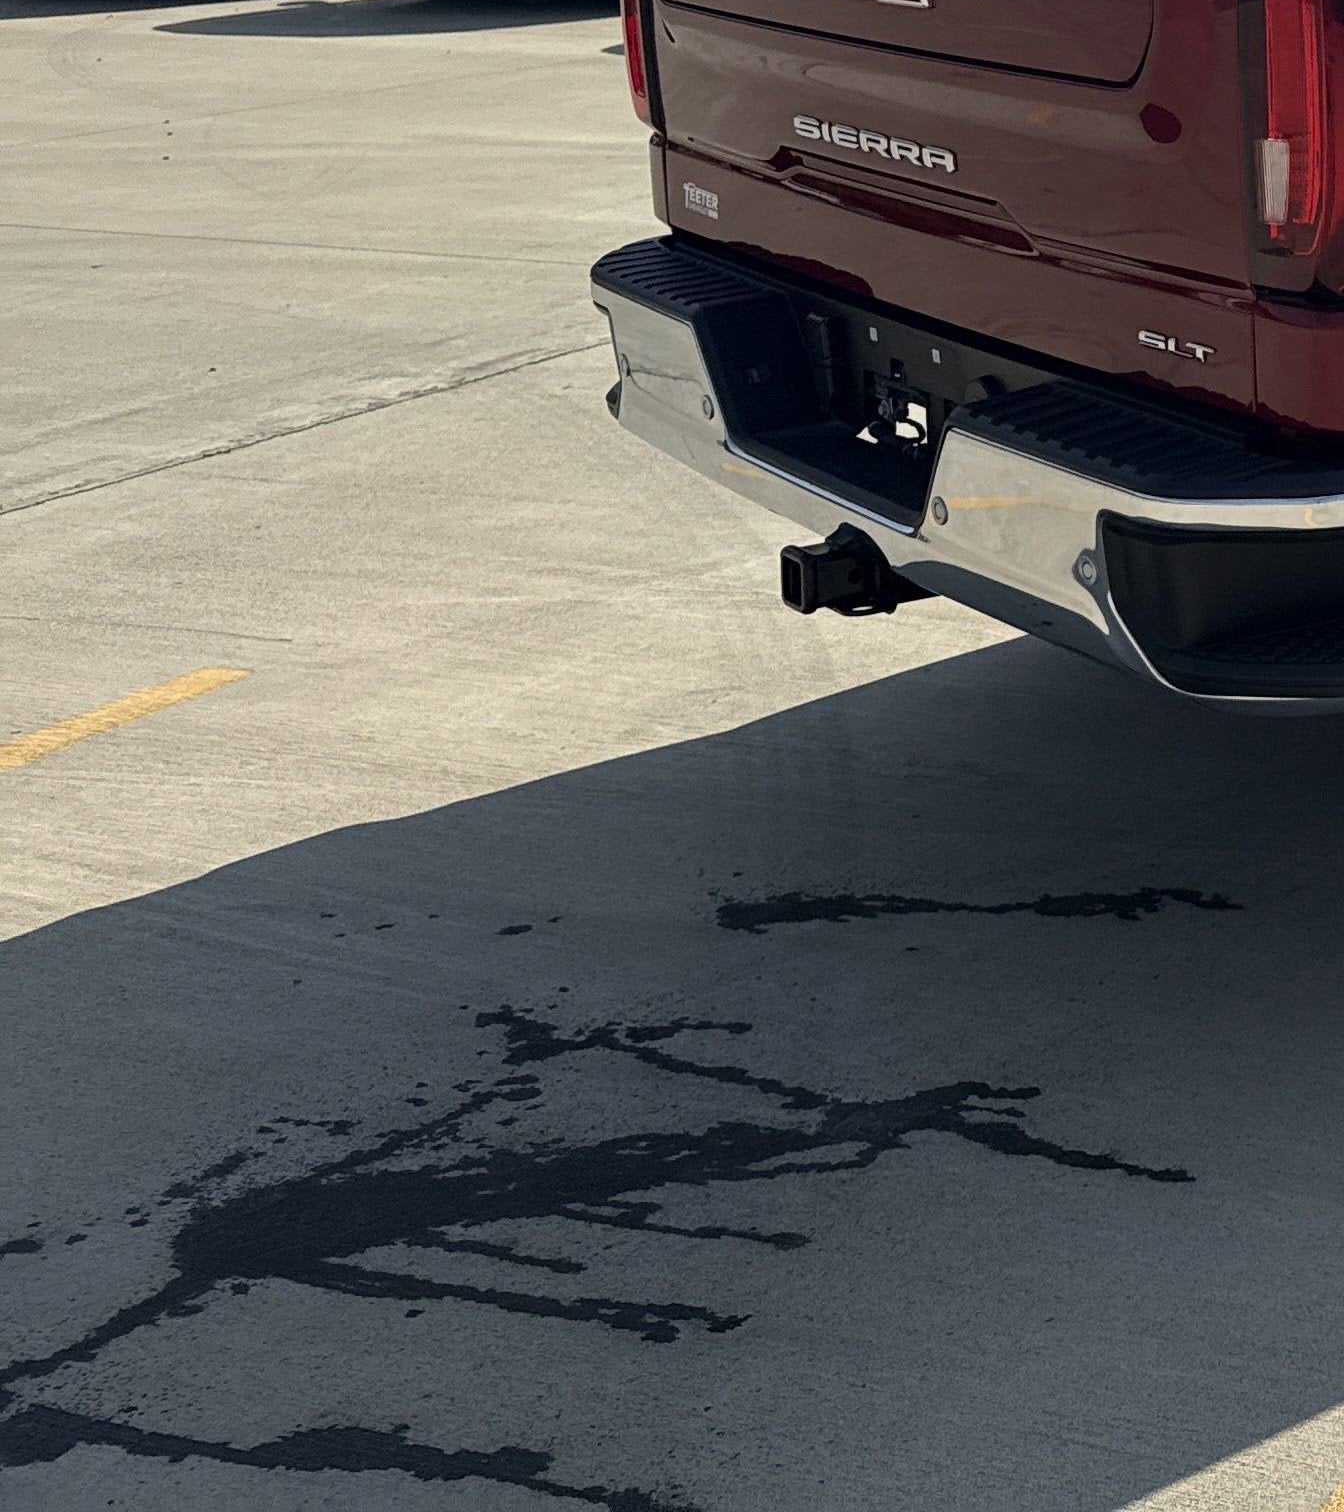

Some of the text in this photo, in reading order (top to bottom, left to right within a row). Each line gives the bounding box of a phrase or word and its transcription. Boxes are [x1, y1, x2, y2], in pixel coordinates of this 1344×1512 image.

[793, 114, 956, 173] SIERRA
[683, 182, 719, 210] TEETER
[1138, 330, 1216, 363] SLT
